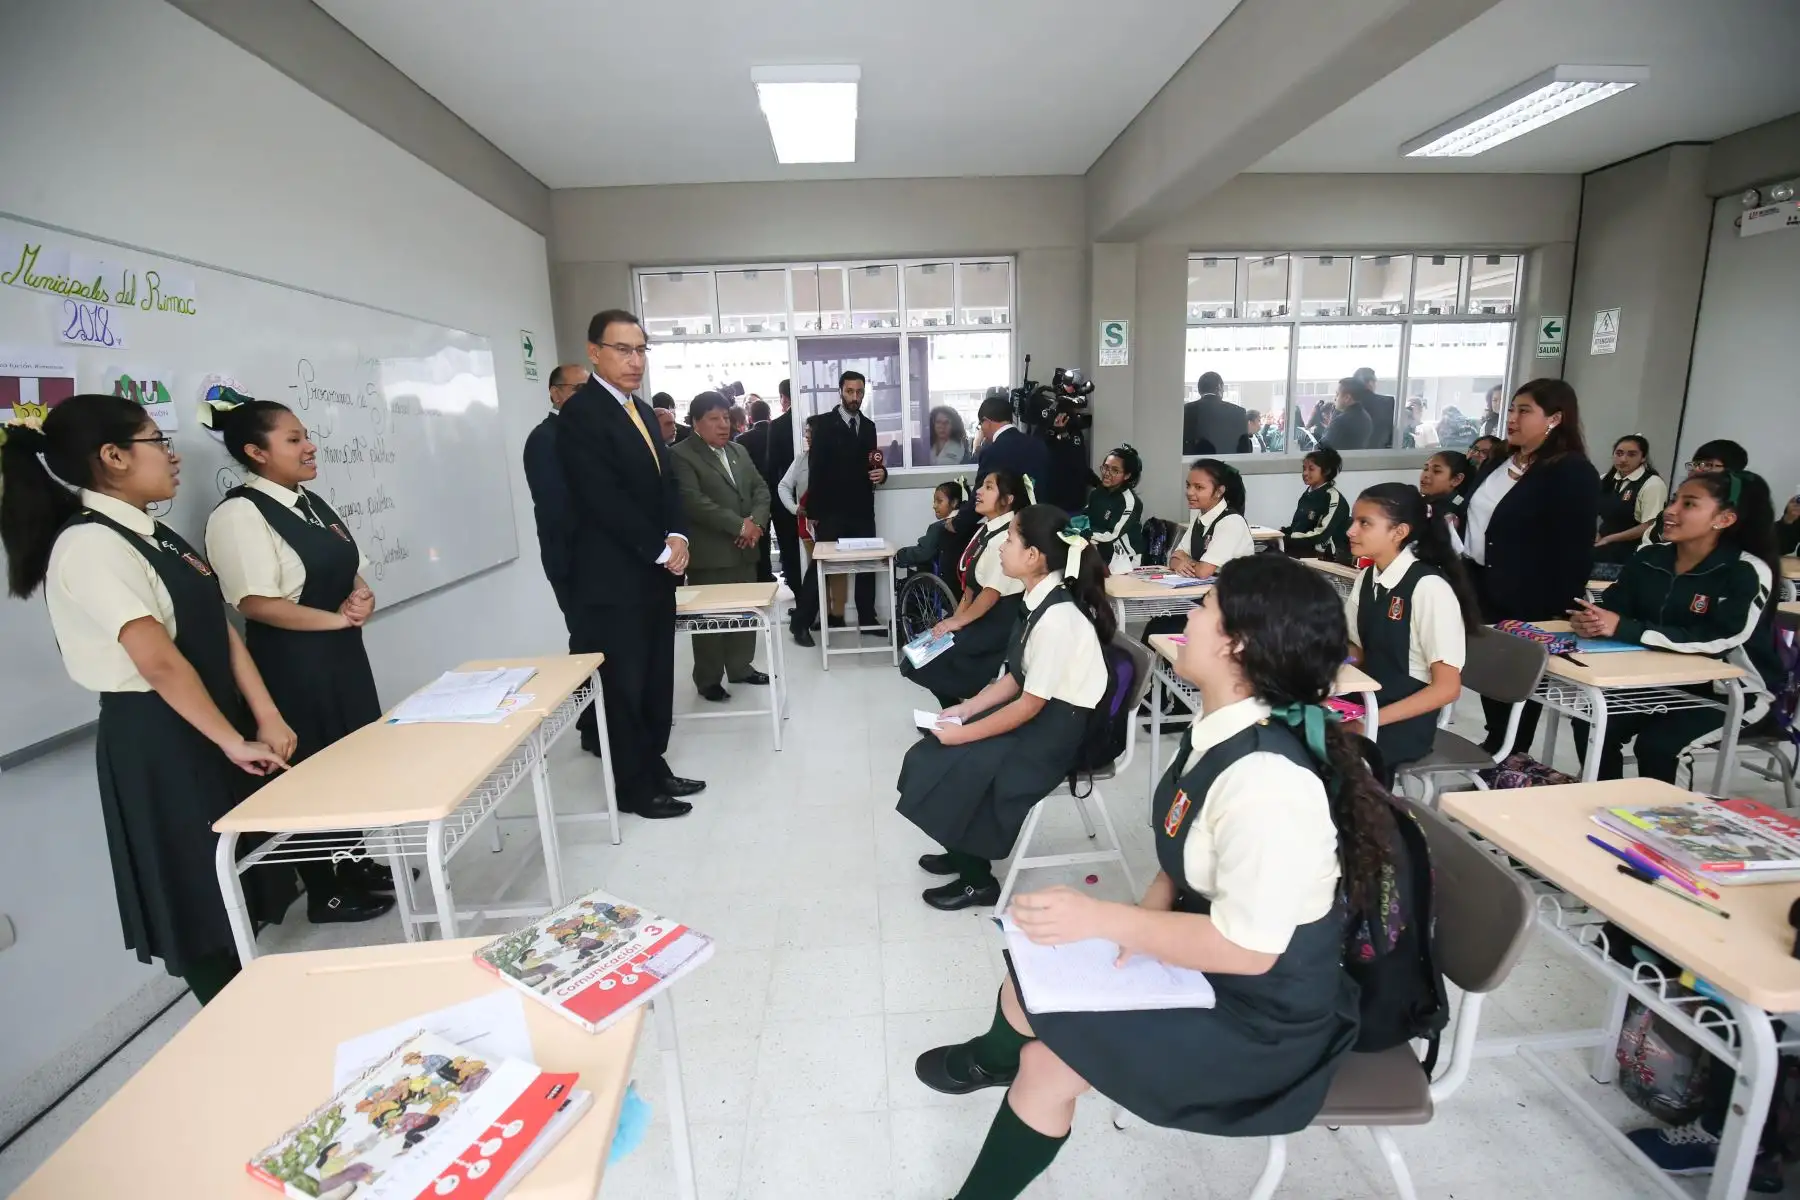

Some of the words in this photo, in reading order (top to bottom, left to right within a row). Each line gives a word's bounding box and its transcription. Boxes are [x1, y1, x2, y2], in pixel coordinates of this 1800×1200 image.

[1, 242, 110, 303] Municipales
[115, 268, 136, 306] del
[62, 298, 115, 347] 2018
[1104, 322, 1124, 347] S
[1539, 346, 1560, 354] SALIDA
[556, 942, 642, 997] Comunicación
[644, 925, 663, 937] 3
